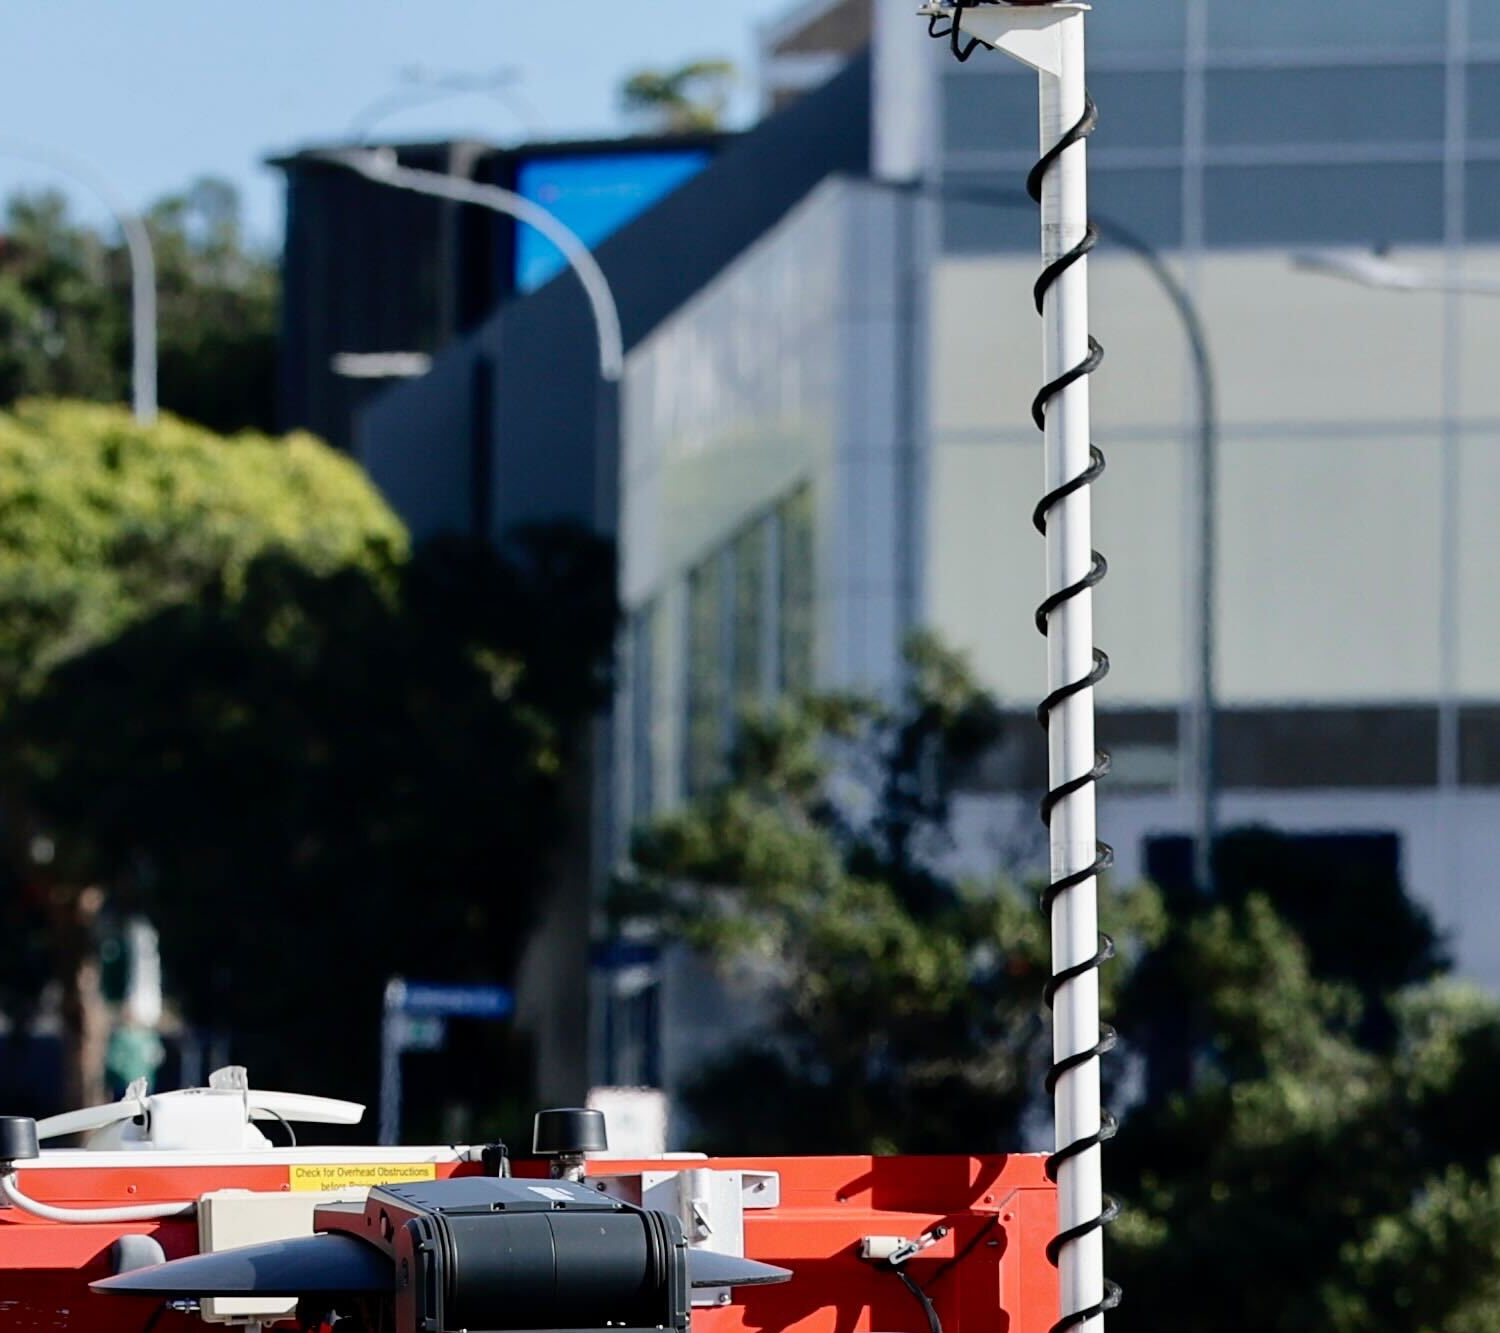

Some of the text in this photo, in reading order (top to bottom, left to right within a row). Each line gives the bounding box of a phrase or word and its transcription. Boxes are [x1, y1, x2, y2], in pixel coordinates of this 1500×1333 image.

[296, 1166, 429, 1178] Check for Overhead Obstructions
